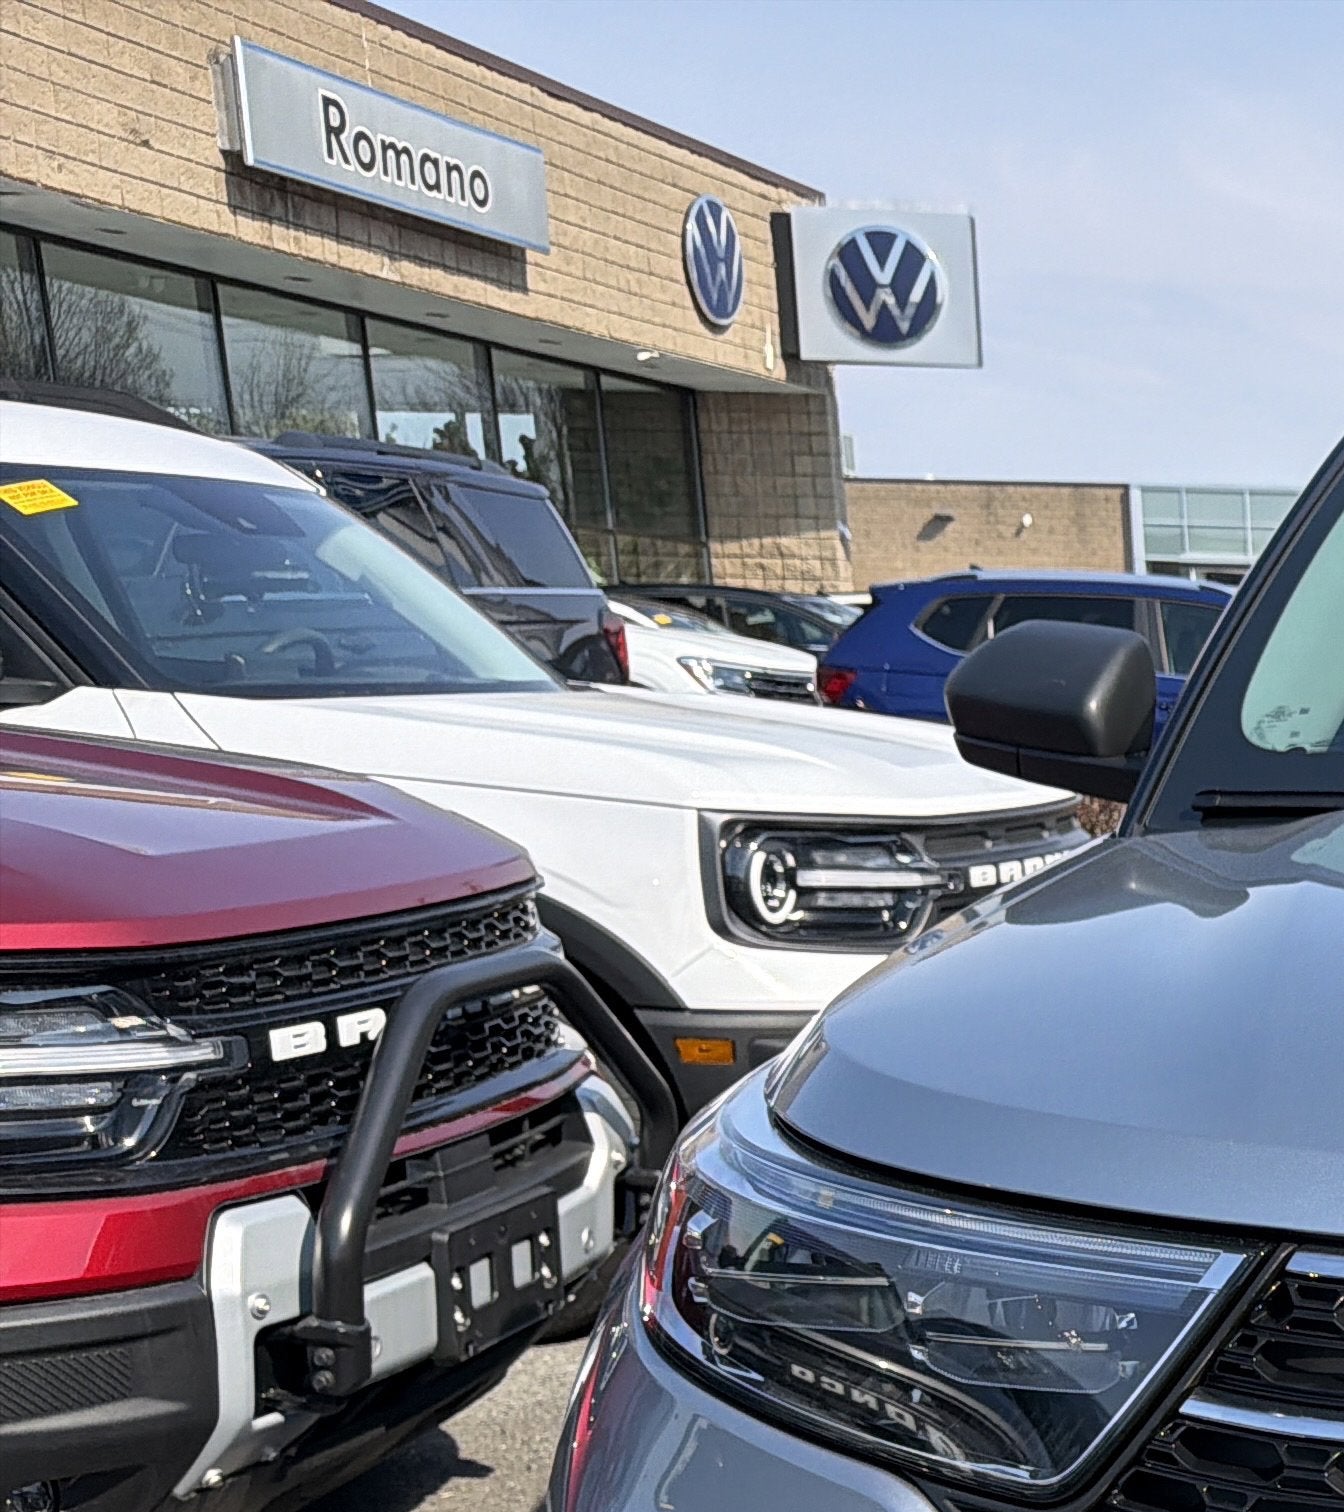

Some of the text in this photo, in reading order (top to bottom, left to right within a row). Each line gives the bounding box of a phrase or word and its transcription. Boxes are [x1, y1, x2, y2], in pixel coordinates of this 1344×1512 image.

[319, 90, 491, 211] Romano
[684, 195, 742, 325] VW
[825, 225, 945, 346] VW
